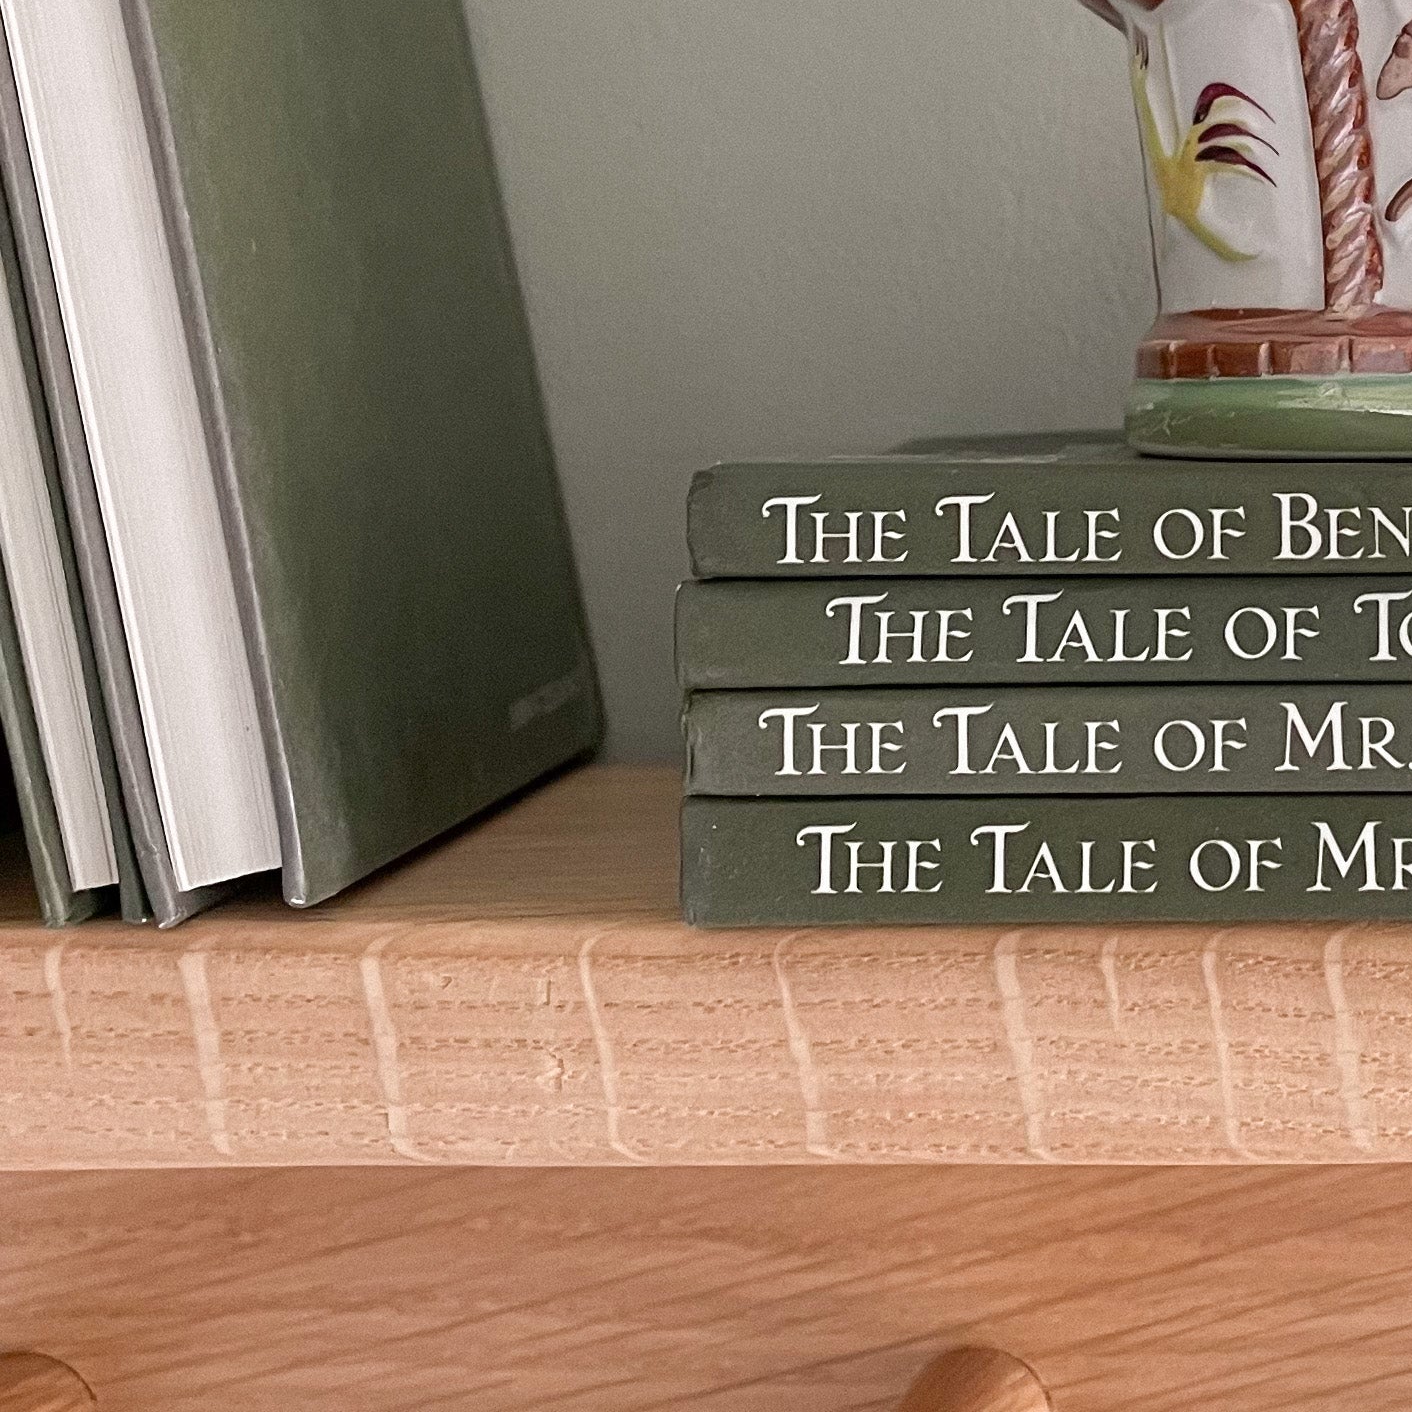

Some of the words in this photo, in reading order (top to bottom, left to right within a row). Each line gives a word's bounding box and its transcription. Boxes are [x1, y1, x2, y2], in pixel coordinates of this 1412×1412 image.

[762, 492, 909, 564] THE
[934, 491, 1123, 563] TALE
[1153, 506, 1246, 560] OF
[825, 591, 974, 665] THE
[1002, 590, 1193, 663] TALE
[1224, 605, 1320, 661] OF
[758, 702, 907, 776] THE
[932, 702, 1123, 775] TALE
[1153, 717, 1247, 773] OF
[796, 821, 943, 894] THE
[970, 821, 1158, 894] TALE
[1189, 837, 1283, 892] OF
